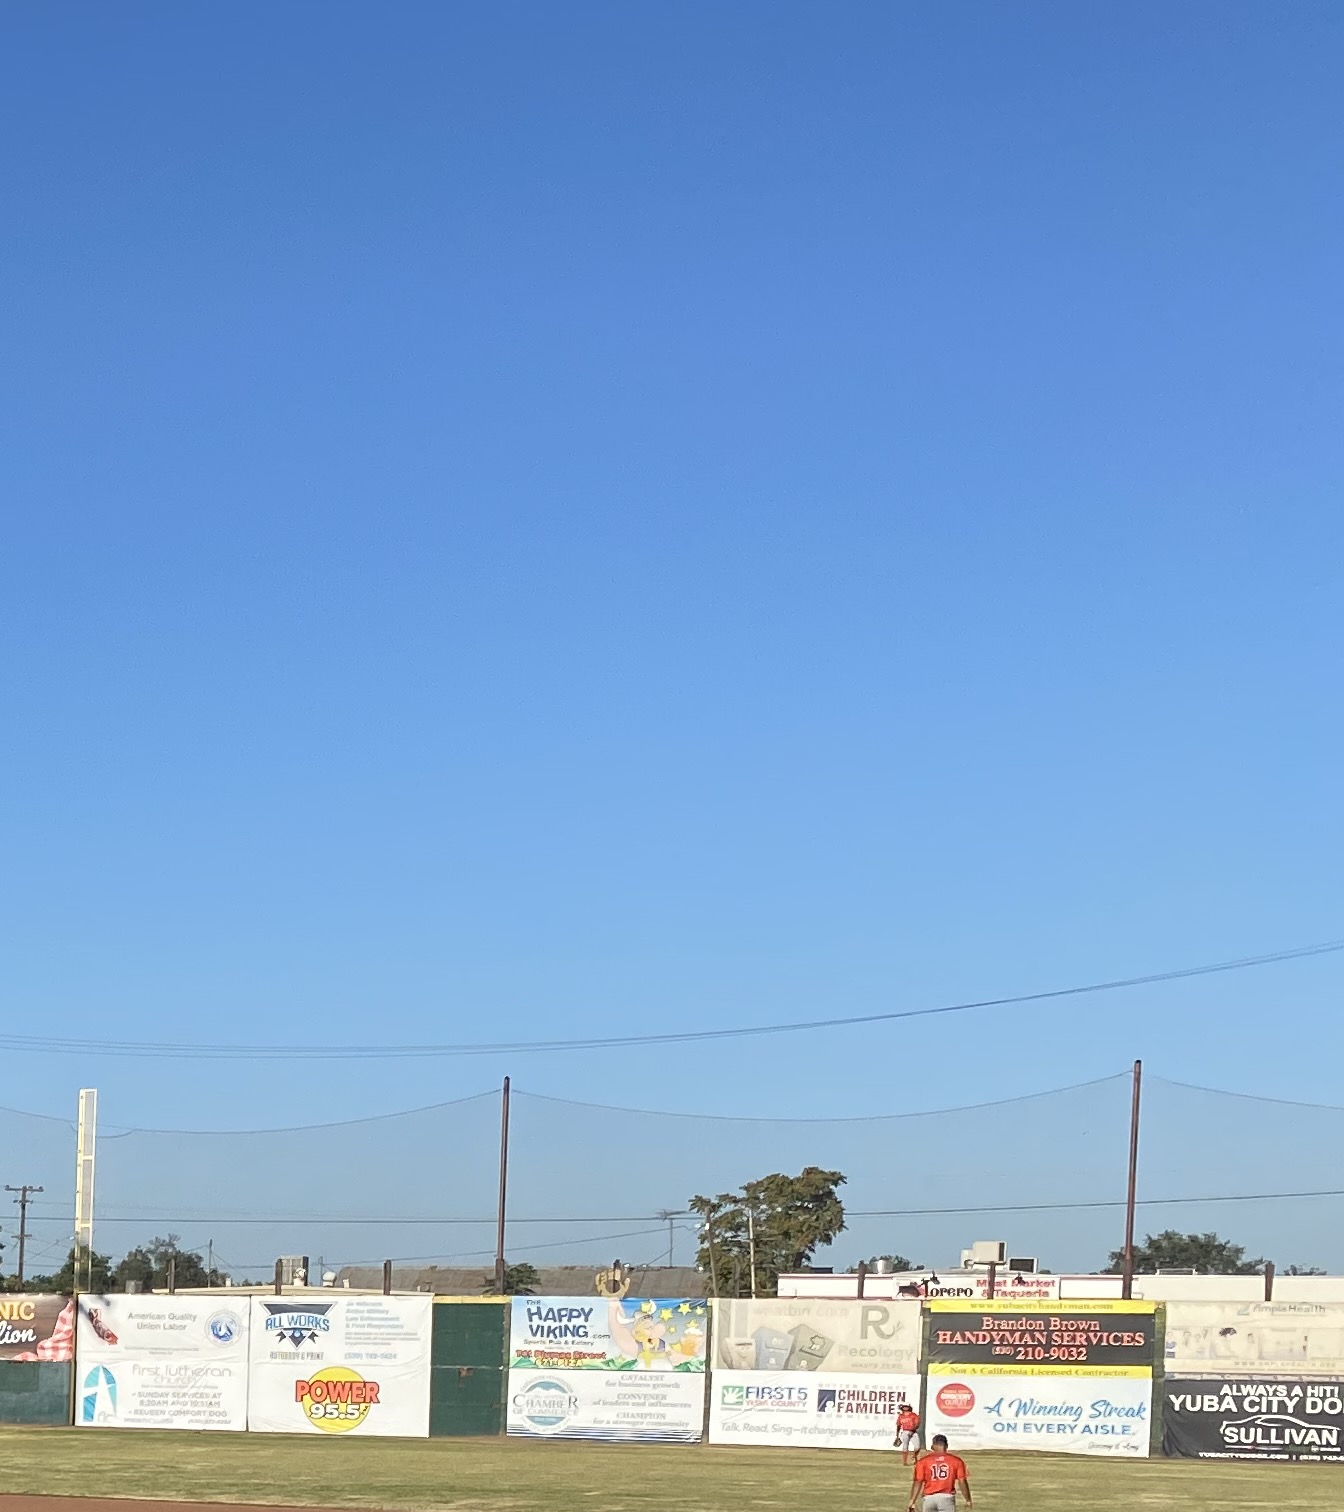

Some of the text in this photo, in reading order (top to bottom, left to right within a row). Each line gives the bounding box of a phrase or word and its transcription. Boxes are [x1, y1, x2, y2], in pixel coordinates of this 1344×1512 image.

[977, 1279, 1007, 1287] Mat
[128, 1312, 198, 1322] American Quality
[526, 1306, 593, 1323] HAPPY
[137, 1322, 187, 1331] Union Labor
[265, 1314, 330, 1331] ALL WORKS
[982, 1317, 1100, 1331] Brandon Brown
[529, 1324, 589, 1340] VIKING
[936, 1331, 1145, 1347] HANDYMAN SERVICES
[838, 1344, 913, 1362] Recology
[1015, 1347, 1087, 1361] 210-9032
[132, 1363, 231, 1377] first lutheran
[981, 1367, 1028, 1375] California
[1031, 1368, 1073, 1376] Licensed
[1075, 1368, 1129, 1377] Contractor
[154, 1375, 197, 1384] church
[620, 1374, 665, 1382] CATALYST
[295, 1380, 380, 1404] POWER
[617, 1392, 667, 1400] CONVENER
[745, 1386, 808, 1401] FIRST 5
[838, 1389, 907, 1403] CHILDREN
[940, 1392, 972, 1400] GROCERY
[1220, 1384, 1339, 1398] ALWAYS A HIT!
[513, 1393, 579, 1409] CHAMBER
[771, 1400, 808, 1408] COUNTY
[1169, 1394, 1344, 1415] YUBA CITY DO
[208, 1410, 227, 1418] DOG
[309, 1403, 361, 1420] 95.5
[616, 1412, 667, 1420] CHAMPION
[983, 1397, 1147, 1422] A Winning Streak
[720, 1422, 741, 1432] Talk,
[808, 1426, 849, 1437] changes
[993, 1422, 1136, 1436] ON EVERY AISLE.
[1223, 1427, 1338, 1445] SULLIVAN
[930, 1462, 950, 1480] 16
